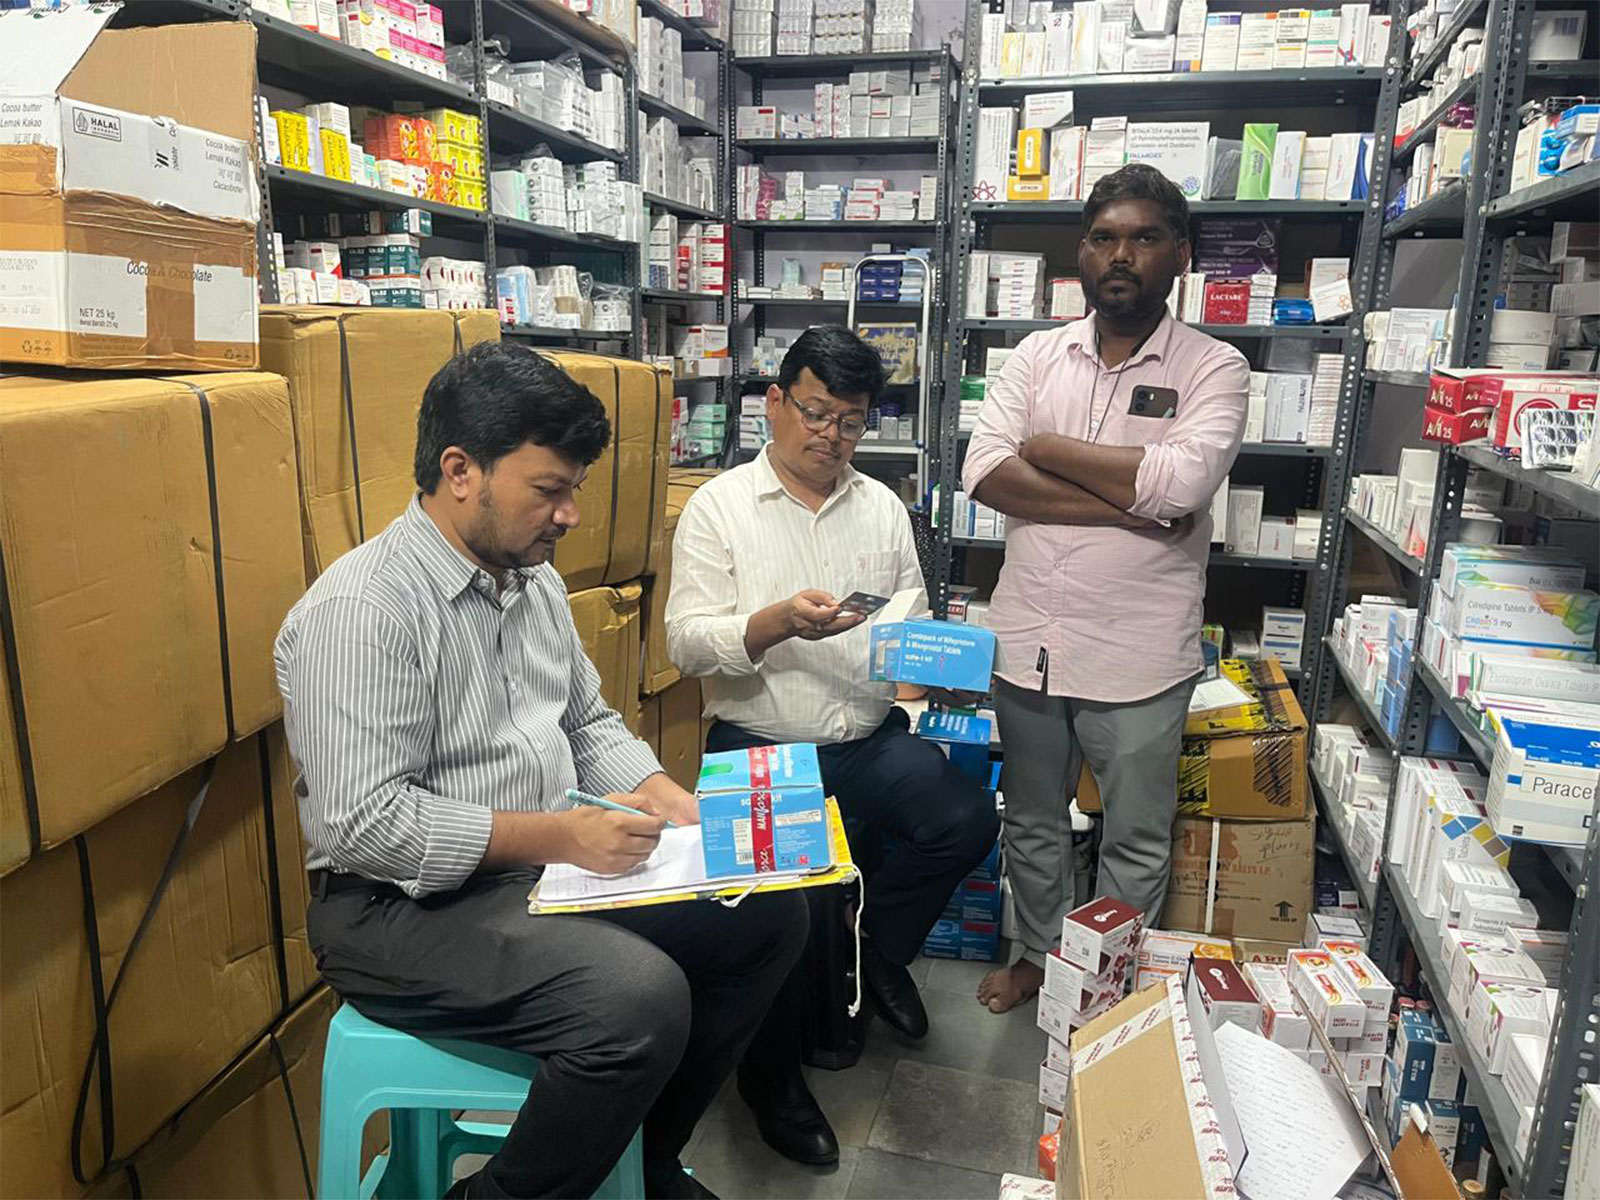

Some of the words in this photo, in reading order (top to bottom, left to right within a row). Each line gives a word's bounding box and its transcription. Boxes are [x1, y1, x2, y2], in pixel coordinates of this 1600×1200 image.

[1, 103, 21, 112] Cocoa
[22, 103, 42, 112] butter
[90, 118, 120, 131] HALAL
[206, 138, 223, 150] Cocoa
[127, 261, 154, 276] Cocoa
[168, 266, 213, 282] Chocolate
[79, 308, 94, 317] NET
[95, 308, 105, 318] 25
[106, 308, 115, 320] kg
[1445, 395, 1454, 407] 25
[1443, 427, 1453, 438] 25
[1532, 776, 1593, 800] Parace
